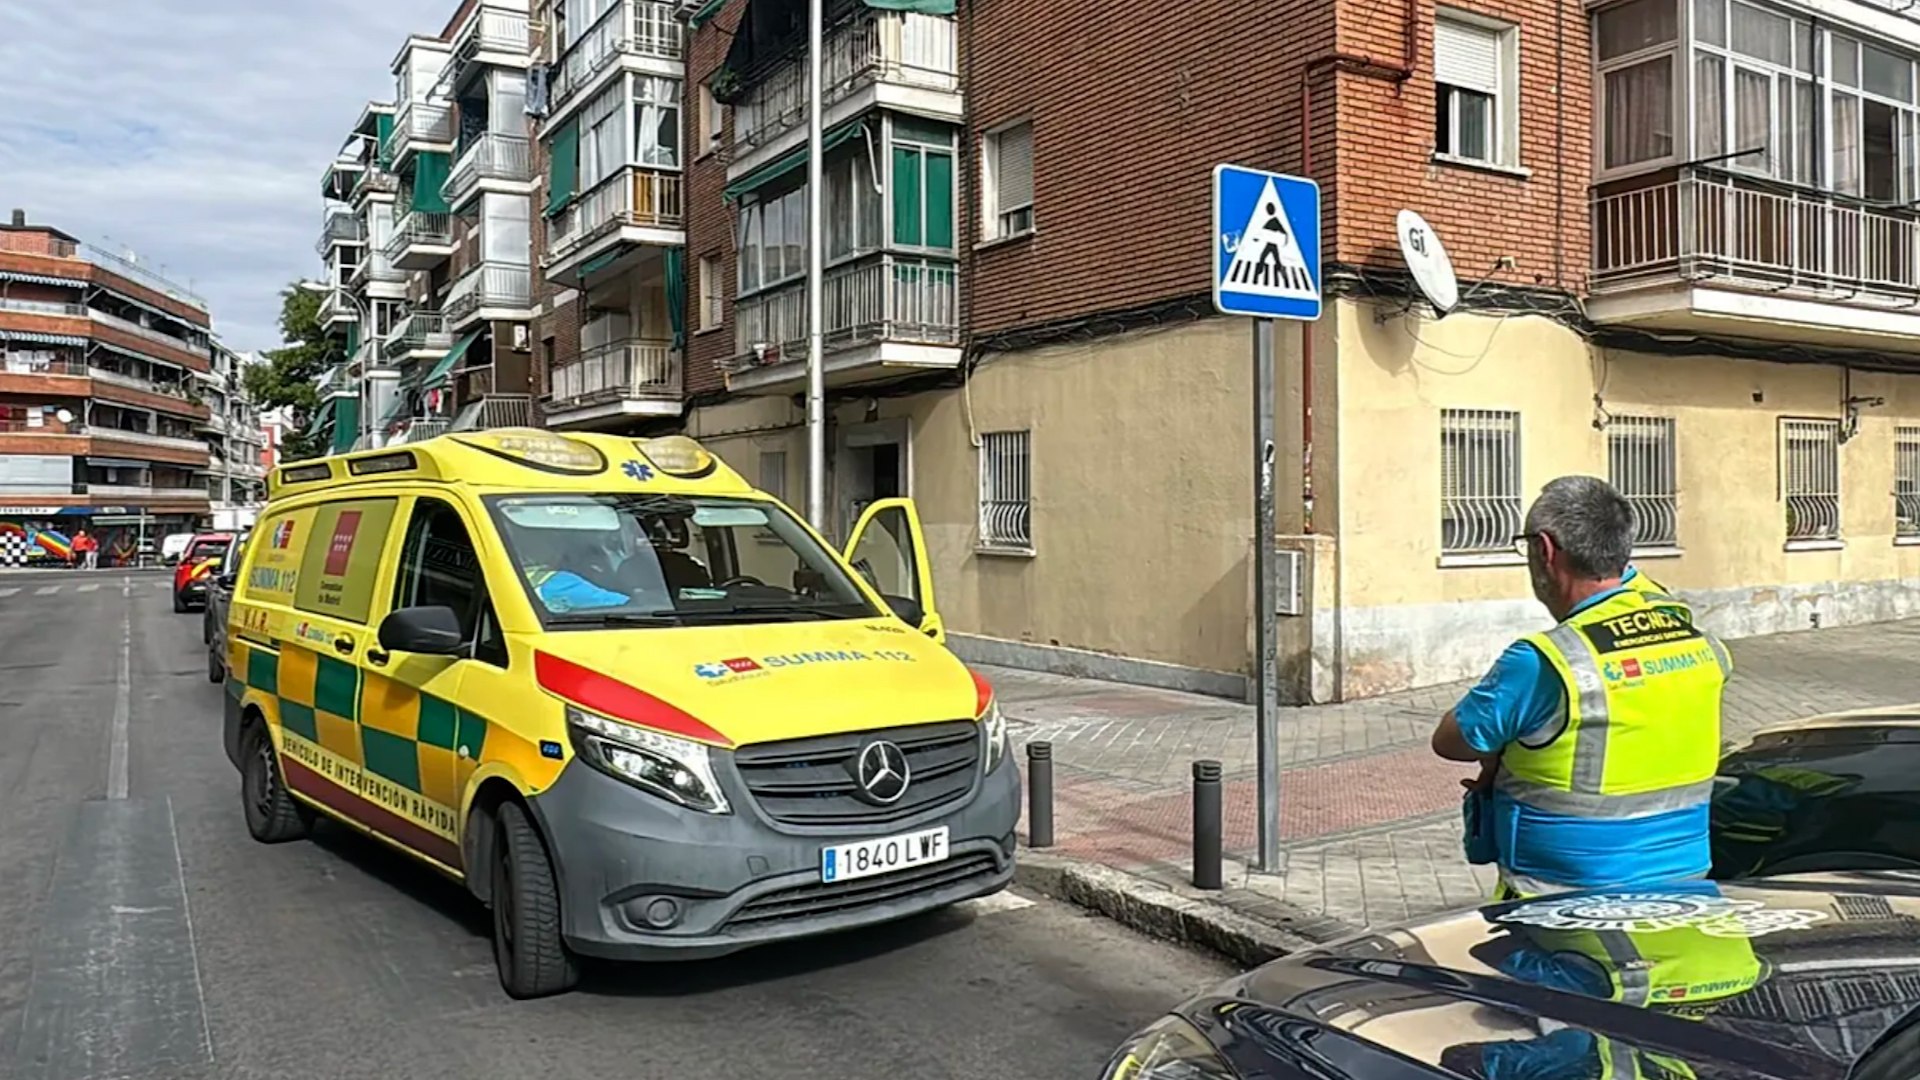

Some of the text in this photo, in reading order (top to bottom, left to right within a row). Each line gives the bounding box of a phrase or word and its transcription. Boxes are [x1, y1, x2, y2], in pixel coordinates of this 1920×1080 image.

[763, 650, 917, 668] SUMMA 112
[1643, 653, 1697, 675] SUMMA
[321, 756, 332, 774] DE
[844, 832, 943, 874] 1840 LWF
